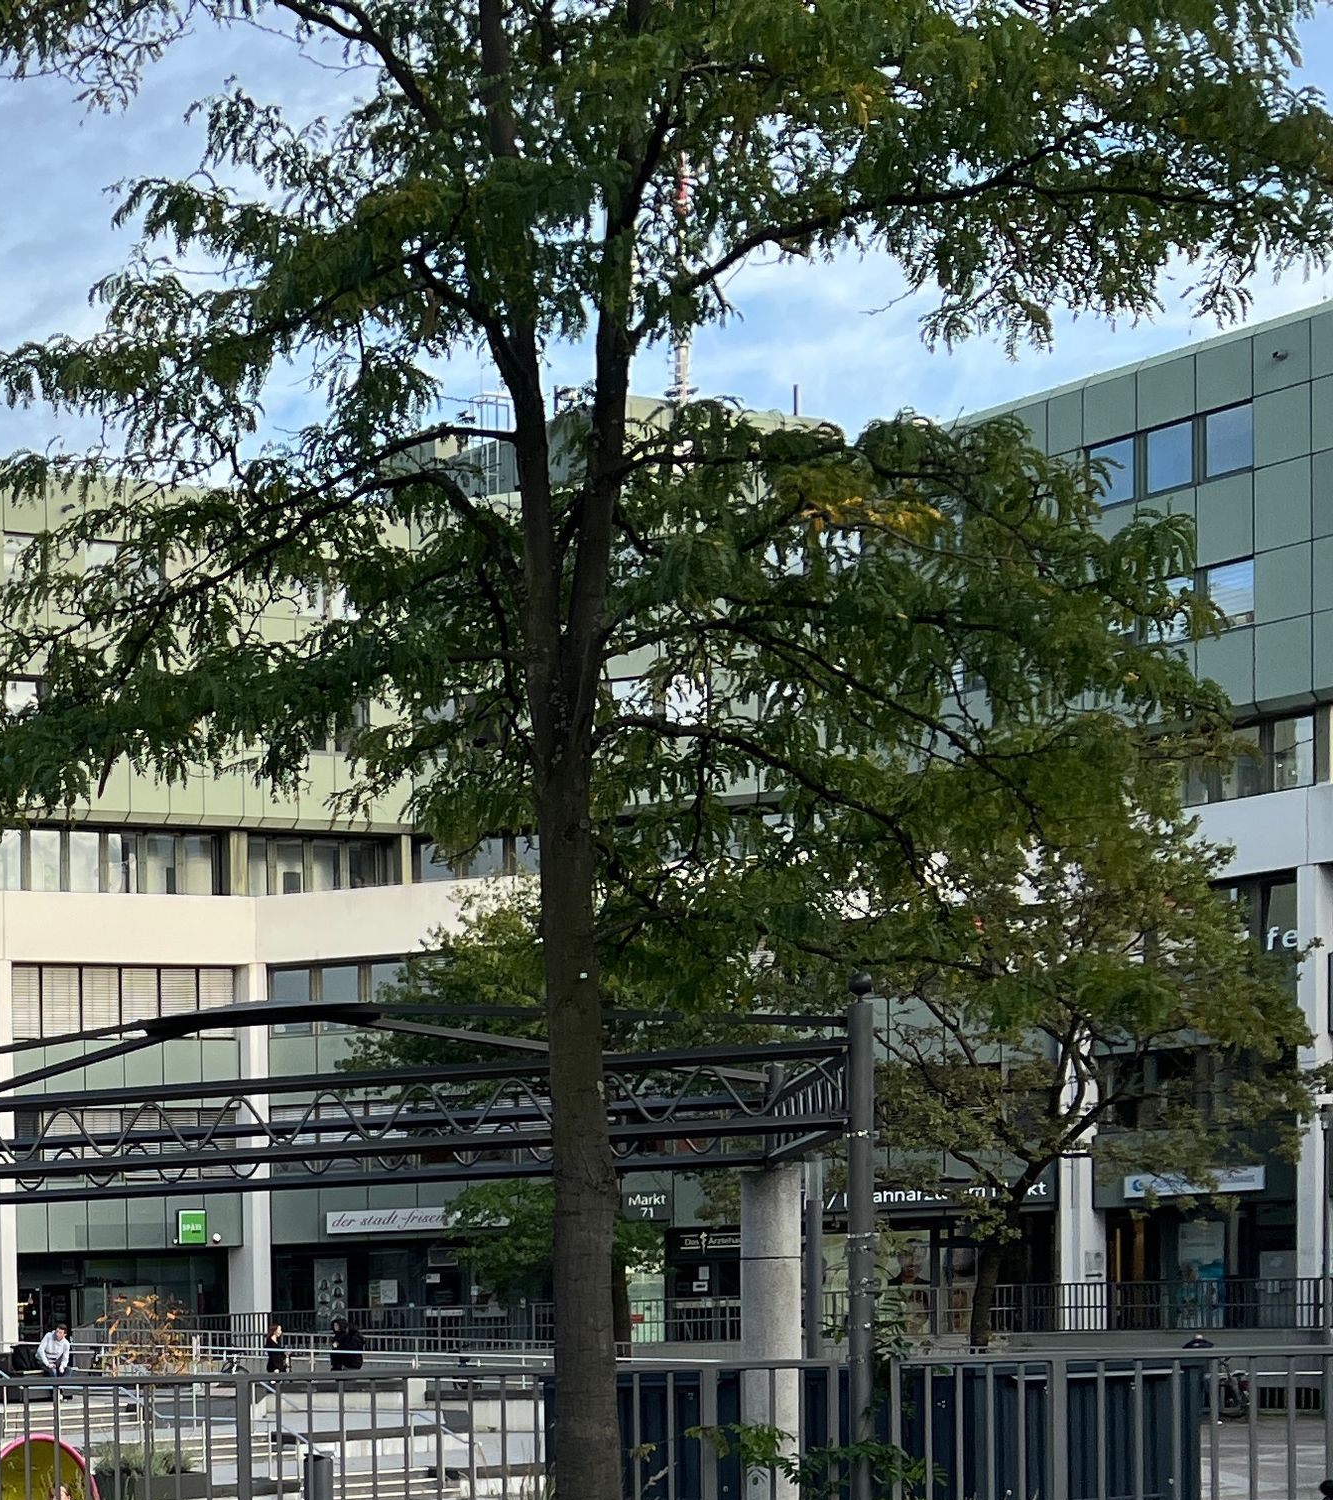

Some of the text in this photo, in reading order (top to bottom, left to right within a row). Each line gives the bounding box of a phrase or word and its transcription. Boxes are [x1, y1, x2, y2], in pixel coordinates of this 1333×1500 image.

[628, 1193, 667, 1206] Markt
[640, 1207, 654, 1218] 71
[331, 1213, 356, 1228] der
